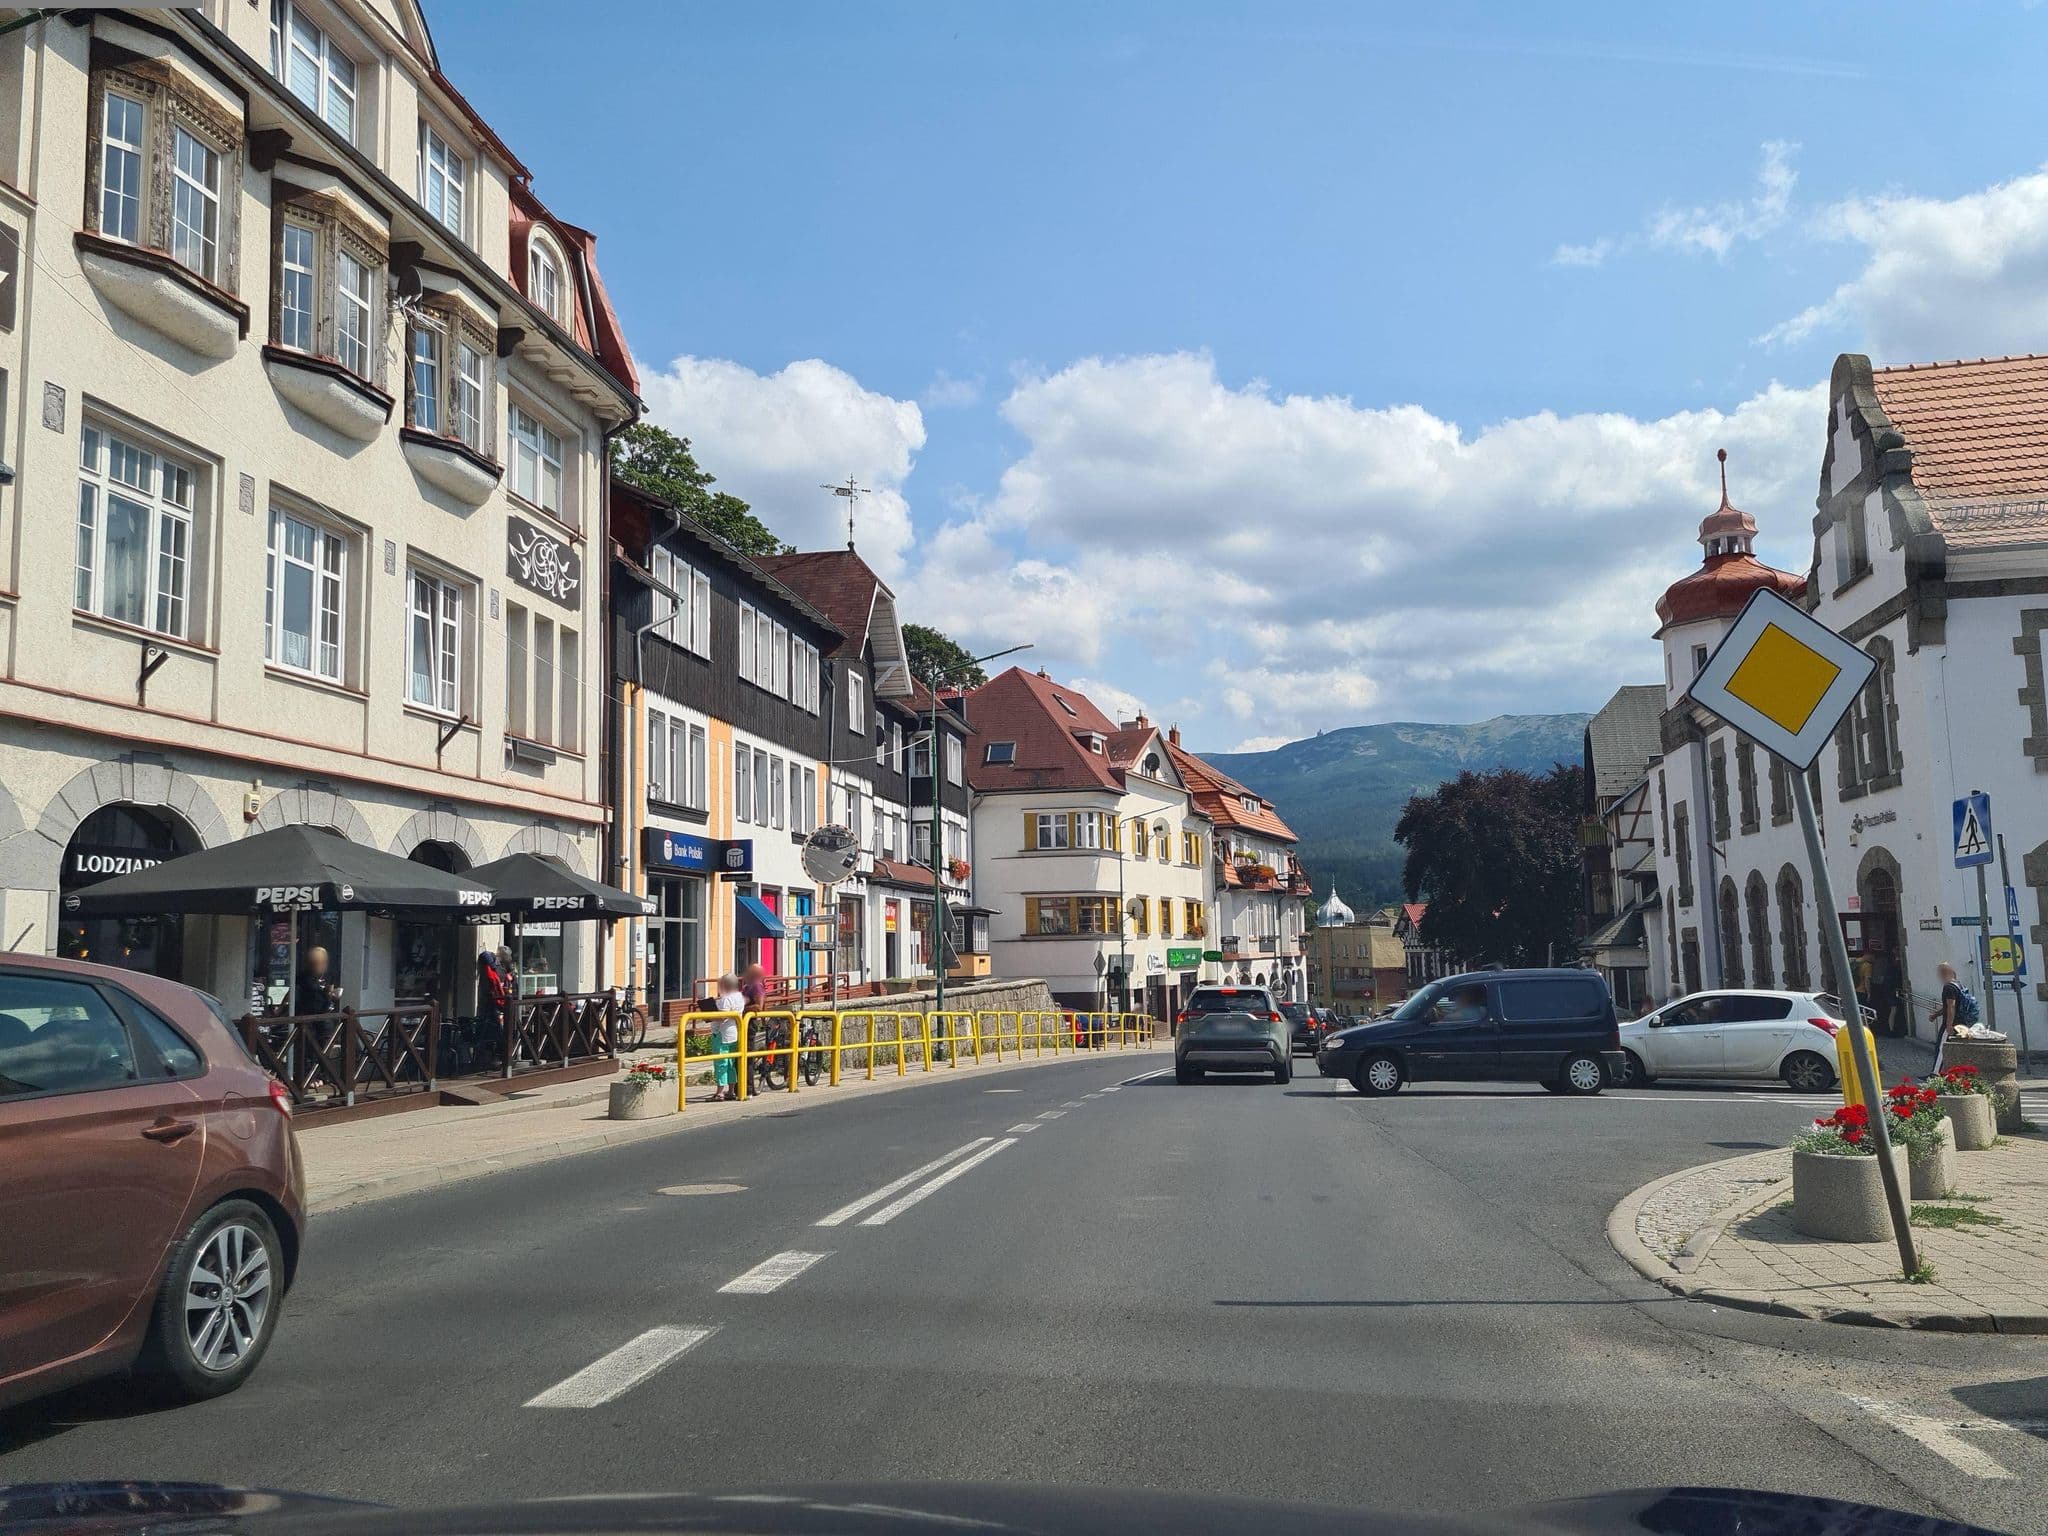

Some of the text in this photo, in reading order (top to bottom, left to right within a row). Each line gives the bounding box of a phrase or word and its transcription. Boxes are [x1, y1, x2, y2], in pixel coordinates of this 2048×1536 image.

[674, 843, 687, 858] Bank
[688, 846, 703, 860] Polski
[77, 854, 163, 874] LODZIA
[256, 887, 320, 903] PEPSI
[459, 890, 492, 905] PEPSI
[533, 896, 585, 909] PEPSI
